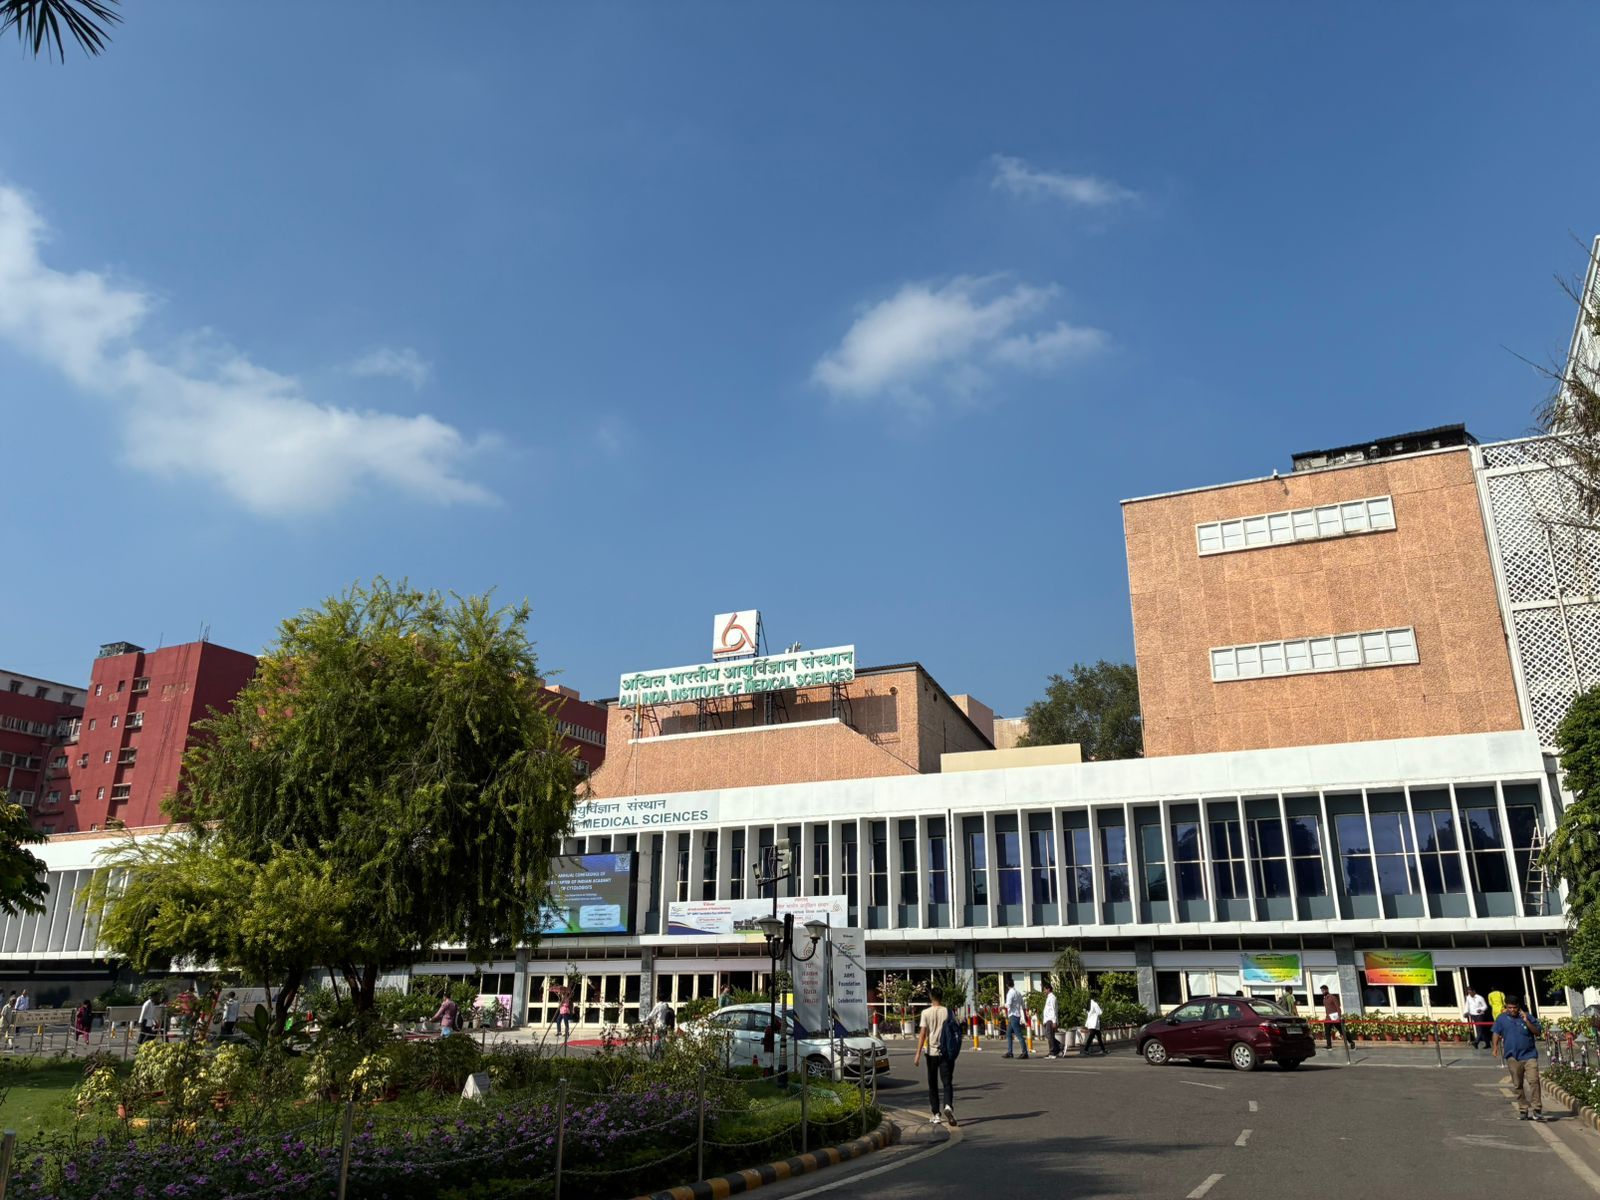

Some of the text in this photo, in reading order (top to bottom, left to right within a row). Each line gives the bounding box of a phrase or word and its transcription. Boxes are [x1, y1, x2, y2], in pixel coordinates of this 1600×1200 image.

[621, 651, 853, 691] अखिल भारतीय आयुर्विज्ञान संस्थान
[620, 668, 853, 706] ALL INDIA INSTITUTE OF MEDICAL SCIENCES
[627, 799, 667, 811] संस्थान
[582, 816, 639, 829] MEDICAL
[642, 810, 709, 825] SCIENCES
